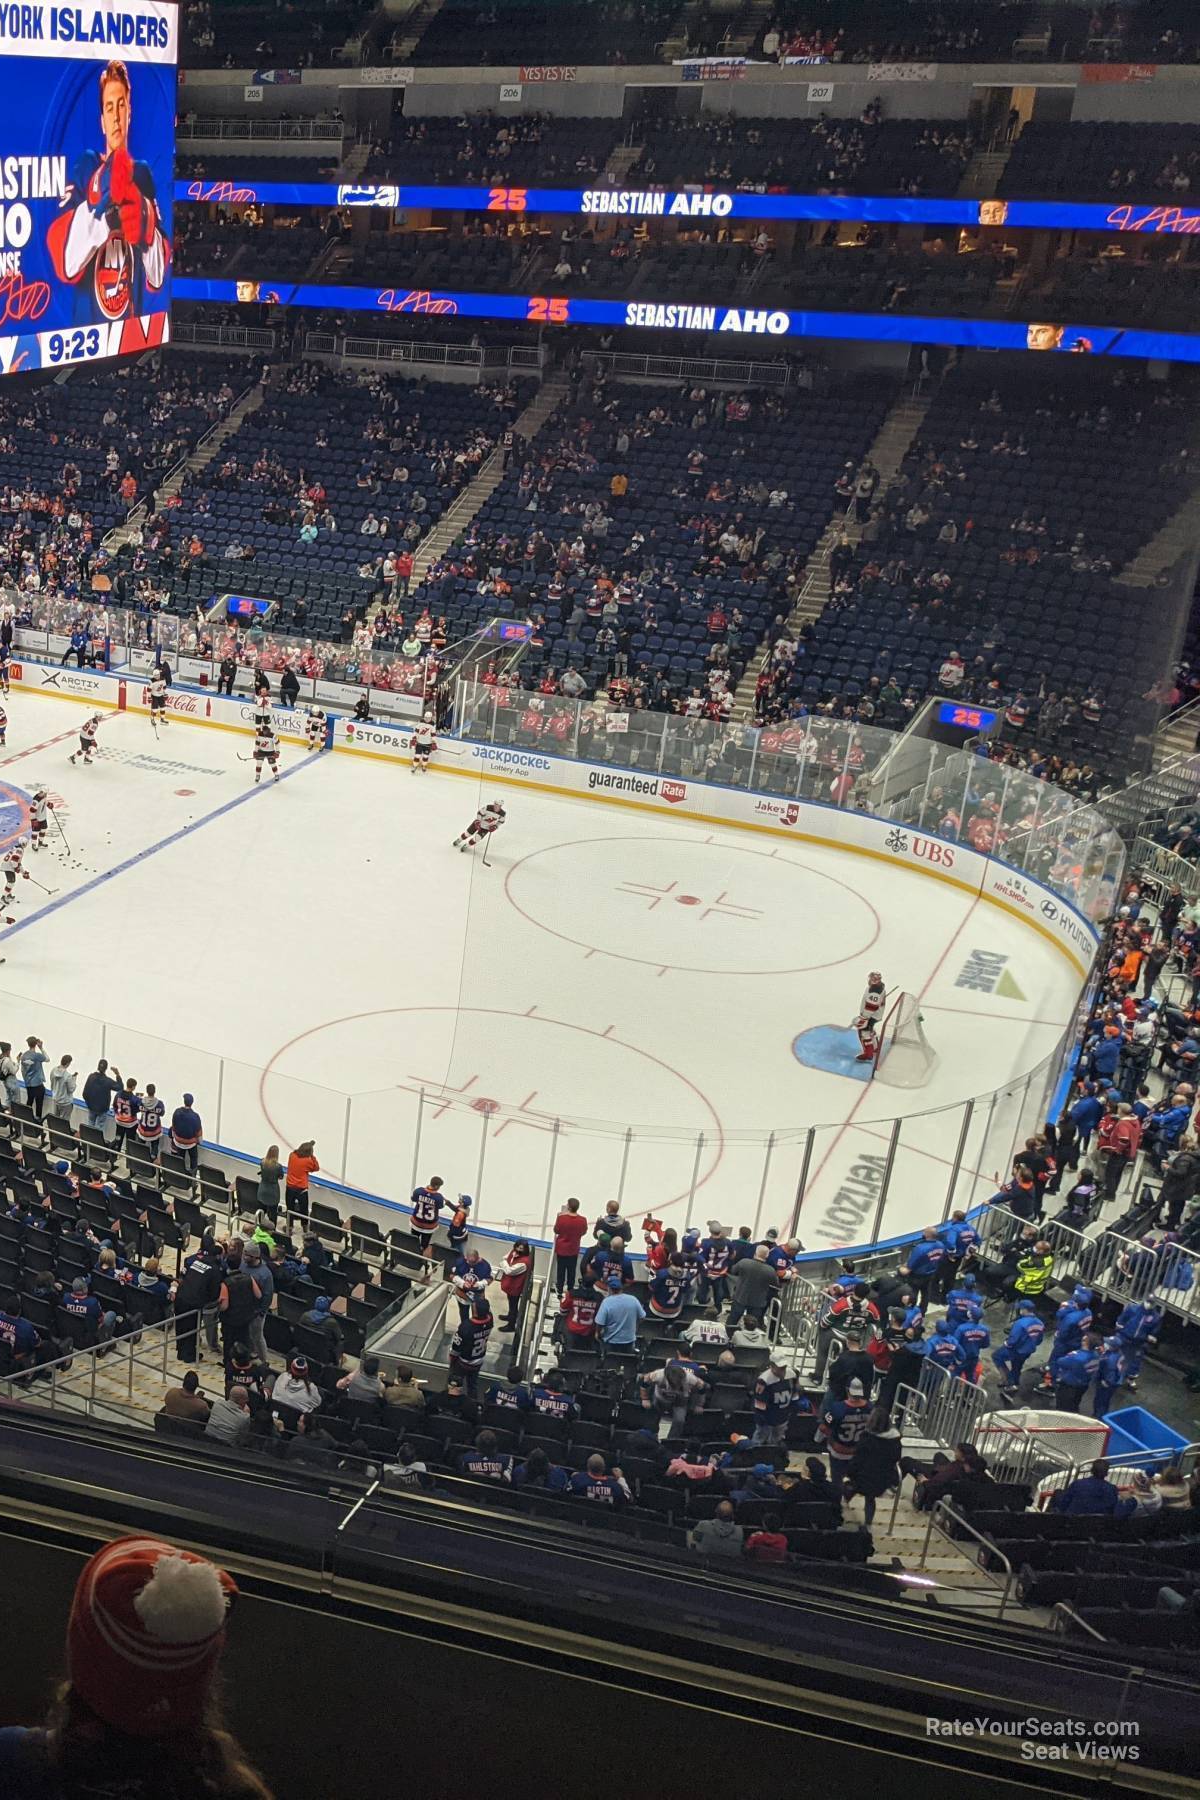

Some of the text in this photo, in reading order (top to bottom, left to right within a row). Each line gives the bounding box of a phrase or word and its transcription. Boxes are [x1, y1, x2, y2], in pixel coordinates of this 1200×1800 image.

[50, 7, 168, 48] ISLANDERS
[503, 88, 518, 98] 206
[812, 88, 828, 97] 207
[488, 189, 526, 210] 25
[582, 191, 733, 216] SEBASTIAN AHO
[527, 298, 569, 321] 25
[625, 303, 789, 334] SEBASTIAN AHO
[49, 328, 100, 363] 9:23
[61, 676, 99, 689] ARCTIX
[952, 709, 981, 728] 25
[136, 753, 226, 777] Northwell
[472, 746, 551, 771] Jackpocket
[490, 763, 529, 777] Lottery App
[588, 770, 685, 798] guaranteed Rate
[755, 801, 785, 814] Jake's
[911, 836, 956, 868] UBS
[116, 1102, 131, 1118] 13
[141, 1113, 157, 1128] 18
[415, 1204, 435, 1221] 13
[667, 1287, 680, 1304] 7
[572, 1308, 596, 1325] 13
[774, 1390, 792, 1408] NY
